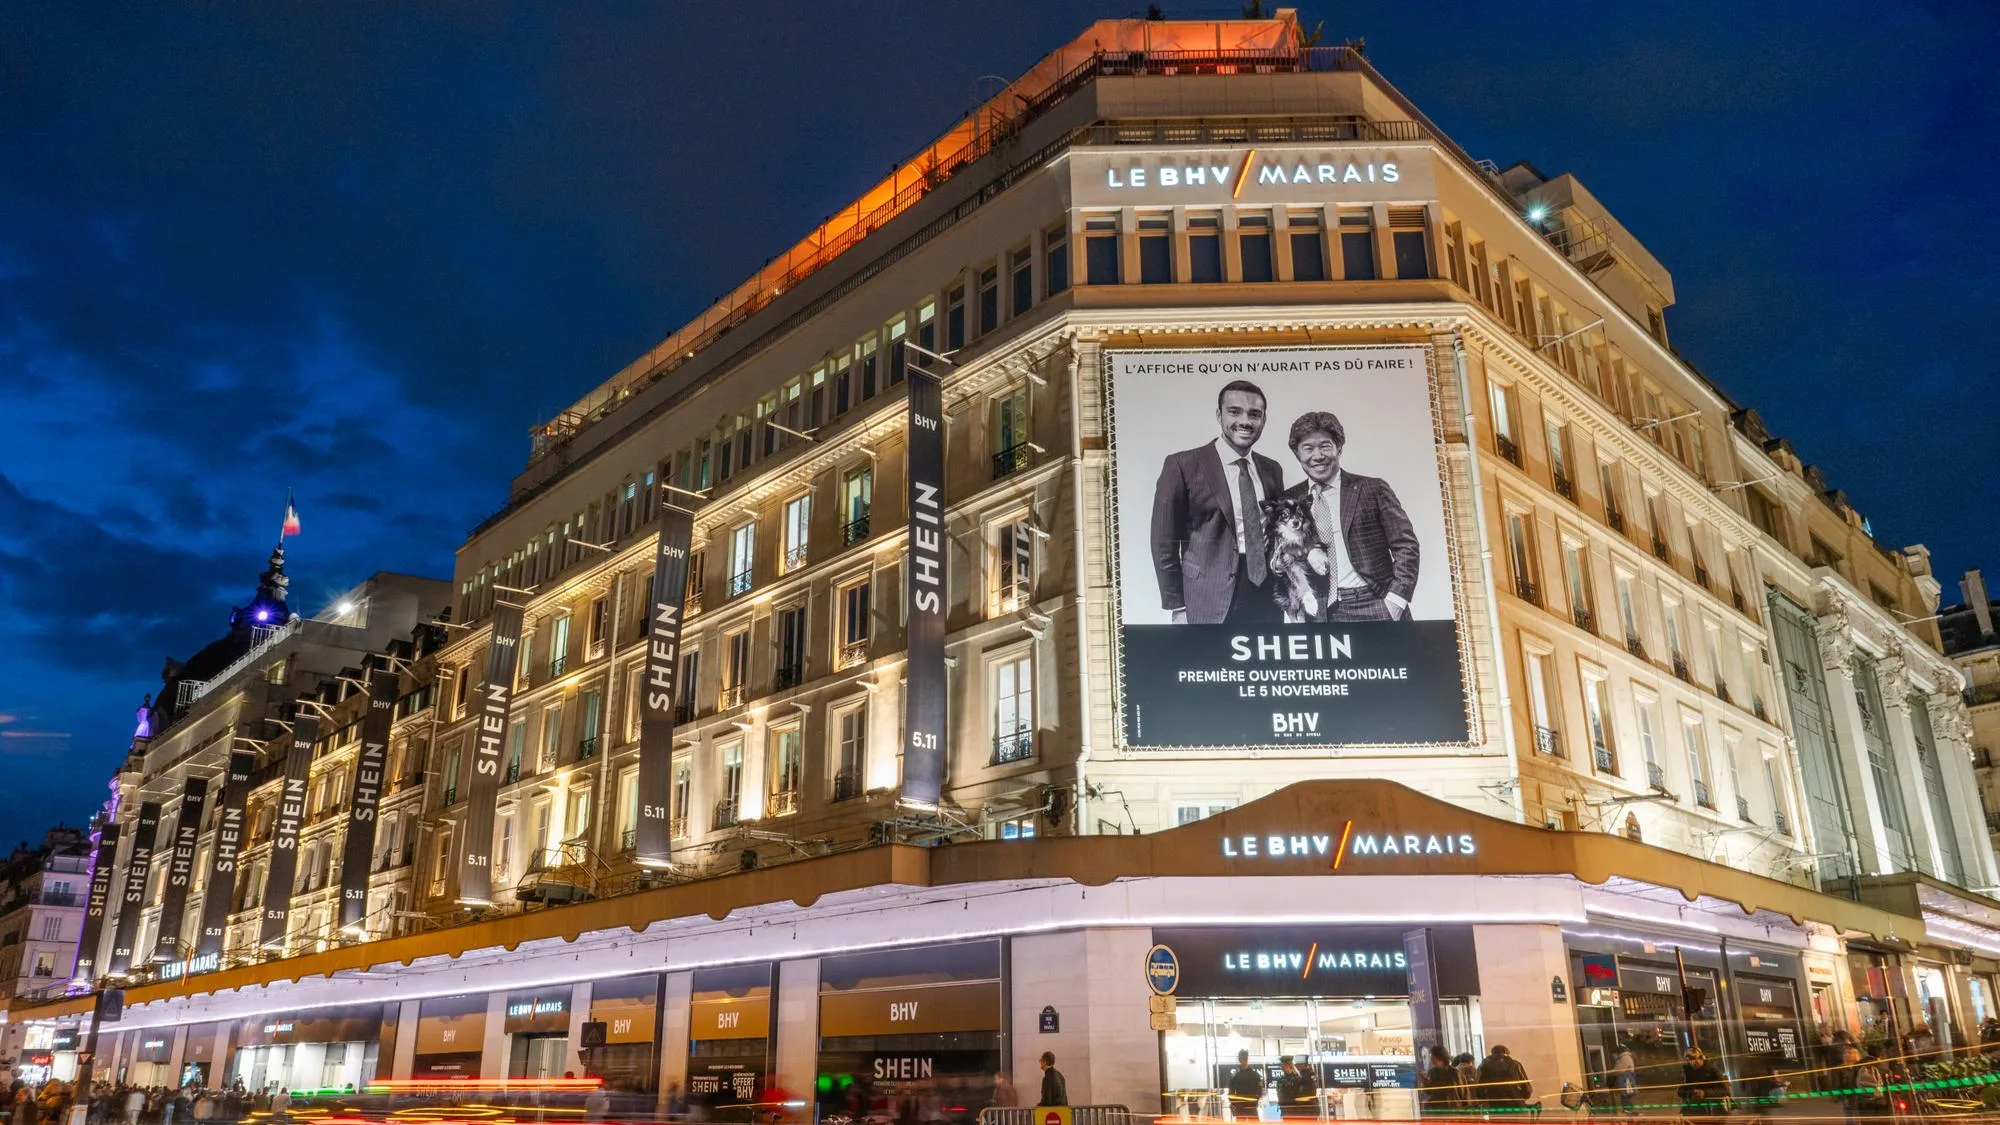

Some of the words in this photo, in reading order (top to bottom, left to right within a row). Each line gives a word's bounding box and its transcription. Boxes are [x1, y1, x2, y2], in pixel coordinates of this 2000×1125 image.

[1108, 168, 1145, 187] LE
[1160, 166, 1230, 186] BHV
[1259, 163, 1400, 185] MARAIS
[1126, 364, 1194, 374] L'AFFICHE
[1199, 363, 1242, 374] QU'ON
[1248, 361, 1310, 372] N'AURAIT
[1315, 361, 1340, 371] PAS
[1345, 358, 1363, 370] DÛ
[1368, 359, 1405, 369] FAIRE
[914, 413, 937, 432] BHV
[663, 545, 685, 560] BHV
[915, 481, 940, 615] SHEIN
[496, 635, 515, 647] BHV
[1231, 634, 1352, 661] SHEIN
[649, 602, 679, 713] SHEIN
[1179, 668, 1245, 682] PREMIÈRE
[1249, 669, 1331, 682] OUVERTURE
[1335, 668, 1407, 680] MONDIALE
[1239, 686, 1255, 697] LE
[1259, 685, 1268, 697] 5
[1272, 684, 1349, 696] NOVEMBRE
[372, 700, 391, 709] BHV
[478, 683, 508, 776] SHEIN
[1272, 712, 1319, 732] BHV
[294, 740, 311, 750] BHV
[912, 731, 937, 750] 5.11
[355, 742, 384, 822] SHEIN
[278, 779, 305, 850] SHEIN
[644, 805, 665, 820] 5.11
[217, 808, 242, 873] SHEIN
[1223, 837, 1258, 856] LE
[1268, 836, 1329, 855] BHV
[1353, 835, 1475, 854] MARAIS
[172, 827, 196, 886] SHEIN
[468, 854, 487, 867] 5.11
[127, 848, 150, 903] SHEIN
[89, 866, 110, 917] SHEIN
[346, 889, 364, 899] 5.11
[268, 910, 284, 920] 5.11
[206, 928, 222, 936] 5.11
[116, 948, 130, 956] 5.11
[1225, 954, 1250, 969] LE
[1257, 954, 1301, 969] BHV
[1319, 953, 1406, 968] MARAIS
[1656, 976, 1671, 992] BHV
[1760, 988, 1772, 1002] BHV
[510, 1005, 518, 1016] LE
[535, 1002, 562, 1013] MARAIS
[890, 1002, 918, 1021] BHV
[614, 1019, 632, 1034] BHV
[718, 1012, 739, 1029] BHV
[443, 1030, 456, 1042] BHV
[1748, 1037, 1771, 1052] SHEIN
[1784, 1044, 1797, 1058] BHV
[873, 1058, 932, 1078] SHEIN
[1333, 1068, 1367, 1077] SHEIN
[692, 1081, 719, 1093] SHEIN
[733, 1077, 755, 1086] OFFERT
[736, 1086, 754, 1099] BHV
